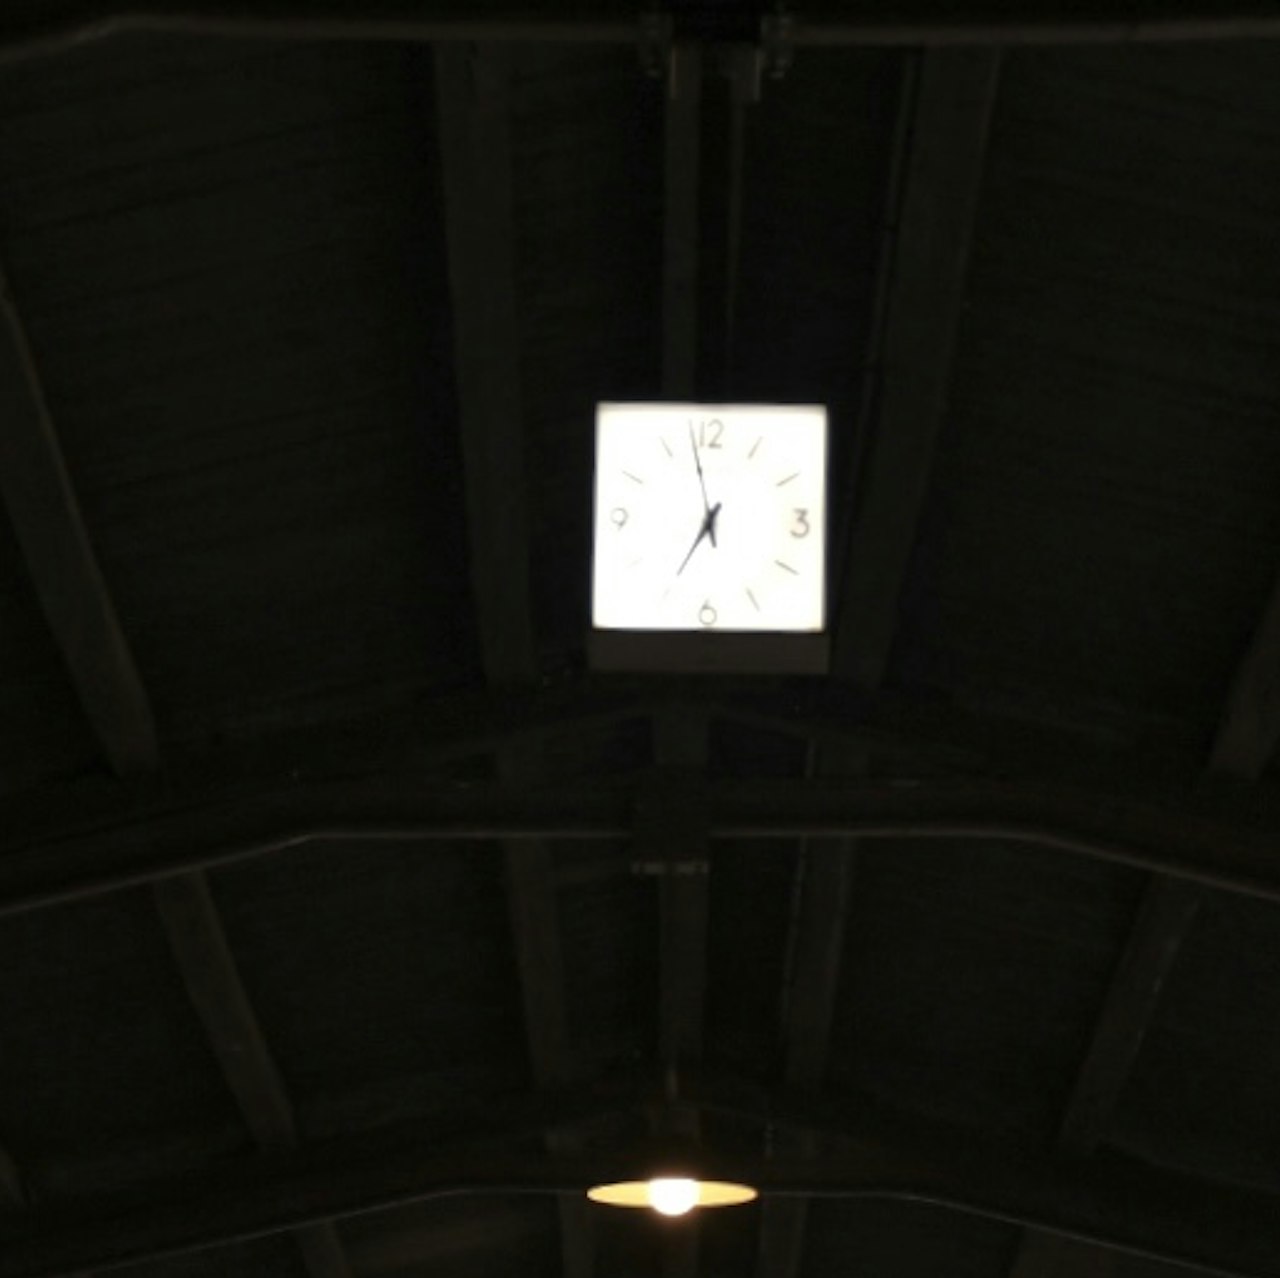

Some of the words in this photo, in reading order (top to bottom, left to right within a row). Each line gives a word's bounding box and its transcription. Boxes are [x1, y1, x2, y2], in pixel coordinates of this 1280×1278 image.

[699, 419, 724, 449] 12
[610, 507, 629, 531] 9
[790, 508, 810, 538] 3
[698, 599, 717, 626] 6
